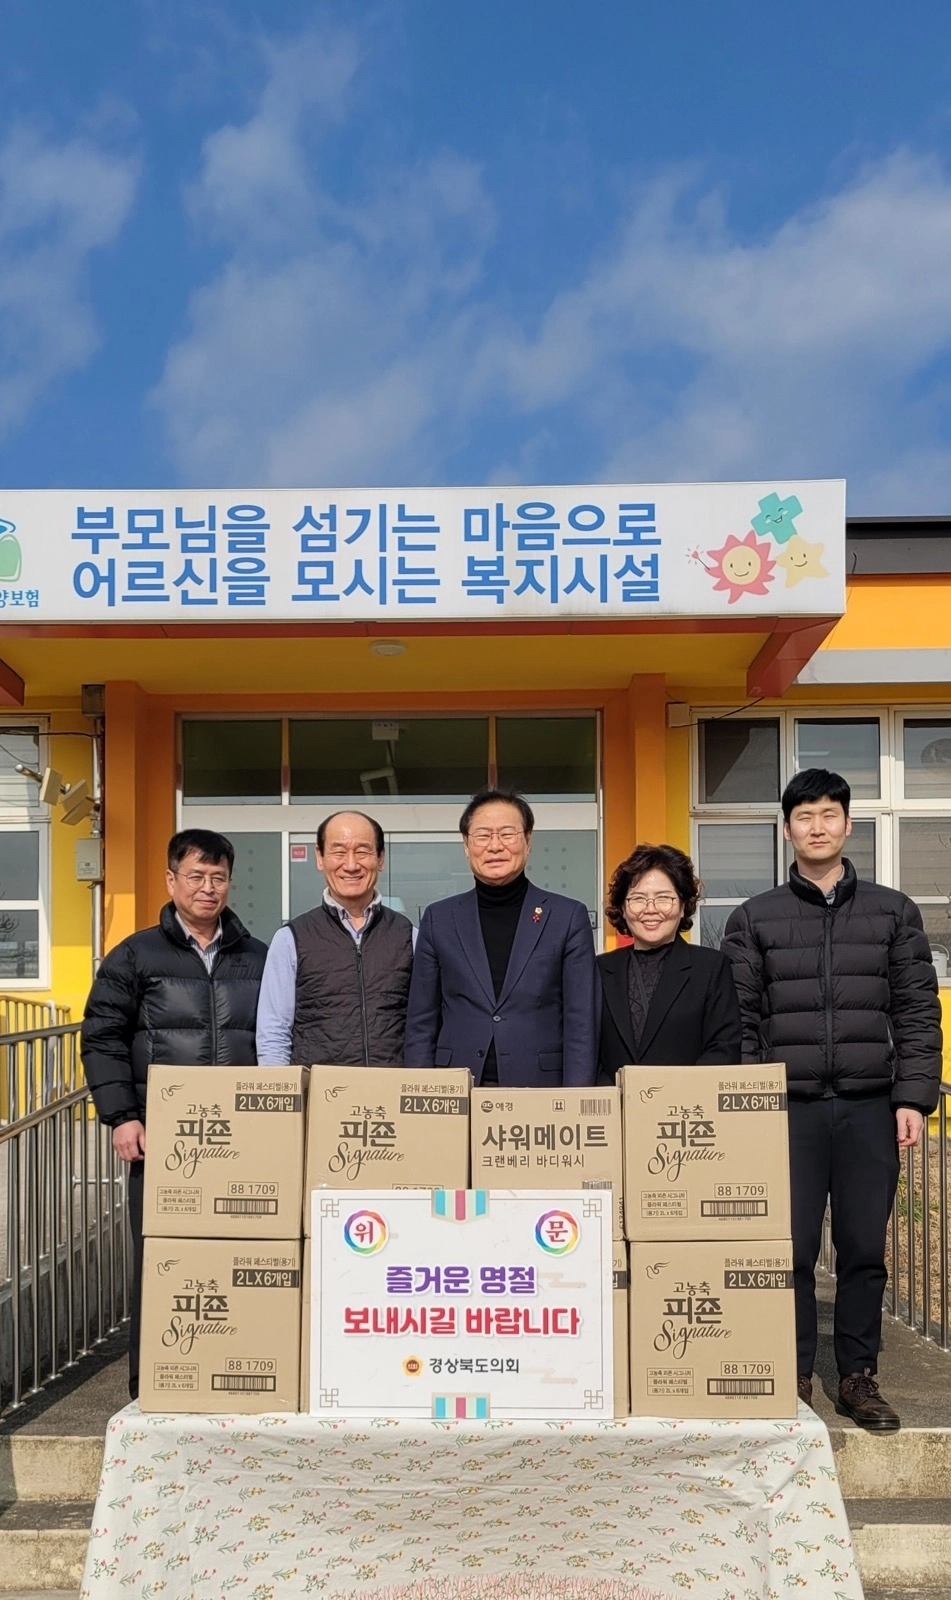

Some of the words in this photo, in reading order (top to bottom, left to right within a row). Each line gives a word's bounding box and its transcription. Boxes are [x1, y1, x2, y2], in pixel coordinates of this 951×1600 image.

[71, 505, 271, 554] 부모님을
[292, 504, 440, 553] 섬기는
[463, 502, 662, 552] 마음으로
[73, 557, 271, 607] 어르신을
[291, 556, 440, 605] 모시는
[461, 553, 661, 604] 복지시설
[235, 1082, 255, 1092] 플라워
[401, 1084, 420, 1093] 플라워
[718, 1081, 738, 1091] 플라워
[185, 1104, 222, 1118] 고농축
[350, 1105, 387, 1119] 고농축
[495, 1102, 513, 1111] 애경
[667, 1105, 705, 1119] 고농축
[175, 1118, 232, 1145] 피죤
[339, 1120, 397, 1147] 피죤
[482, 1124, 608, 1151] 샤워메이트
[656, 1120, 716, 1148] 피죤
[165, 1140, 240, 1179] Signature
[328, 1142, 405, 1181] Signature
[482, 1155, 530, 1168] 크랜베리
[536, 1154, 585, 1168] 바디워시
[647, 1143, 726, 1182] Signature
[230, 1184, 244, 1194] 88
[249, 1184, 276, 1194] 1709
[718, 1186, 732, 1196] 88
[736, 1185, 764, 1195] 1709
[353, 1220, 374, 1244] 위
[545, 1221, 569, 1243] 문
[233, 1257, 252, 1266] 플라워
[724, 1258, 744, 1267] 플라워
[182, 1279, 219, 1293] 고농축
[386, 1265, 469, 1294] 즐거운
[480, 1266, 536, 1294] 명절
[673, 1281, 711, 1296] 고농축
[171, 1294, 229, 1321] 피죤
[662, 1296, 723, 1325] 피죤
[343, 1307, 456, 1336] 보내시길
[465, 1306, 581, 1336] 바랍니다
[161, 1315, 238, 1355] Signature
[653, 1319, 733, 1360] Signature
[228, 1360, 242, 1371] 88
[246, 1361, 274, 1371] 1709
[429, 1358, 519, 1374] 경상북도의회
[724, 1364, 738, 1374] 88
[742, 1364, 771, 1374] 1709
